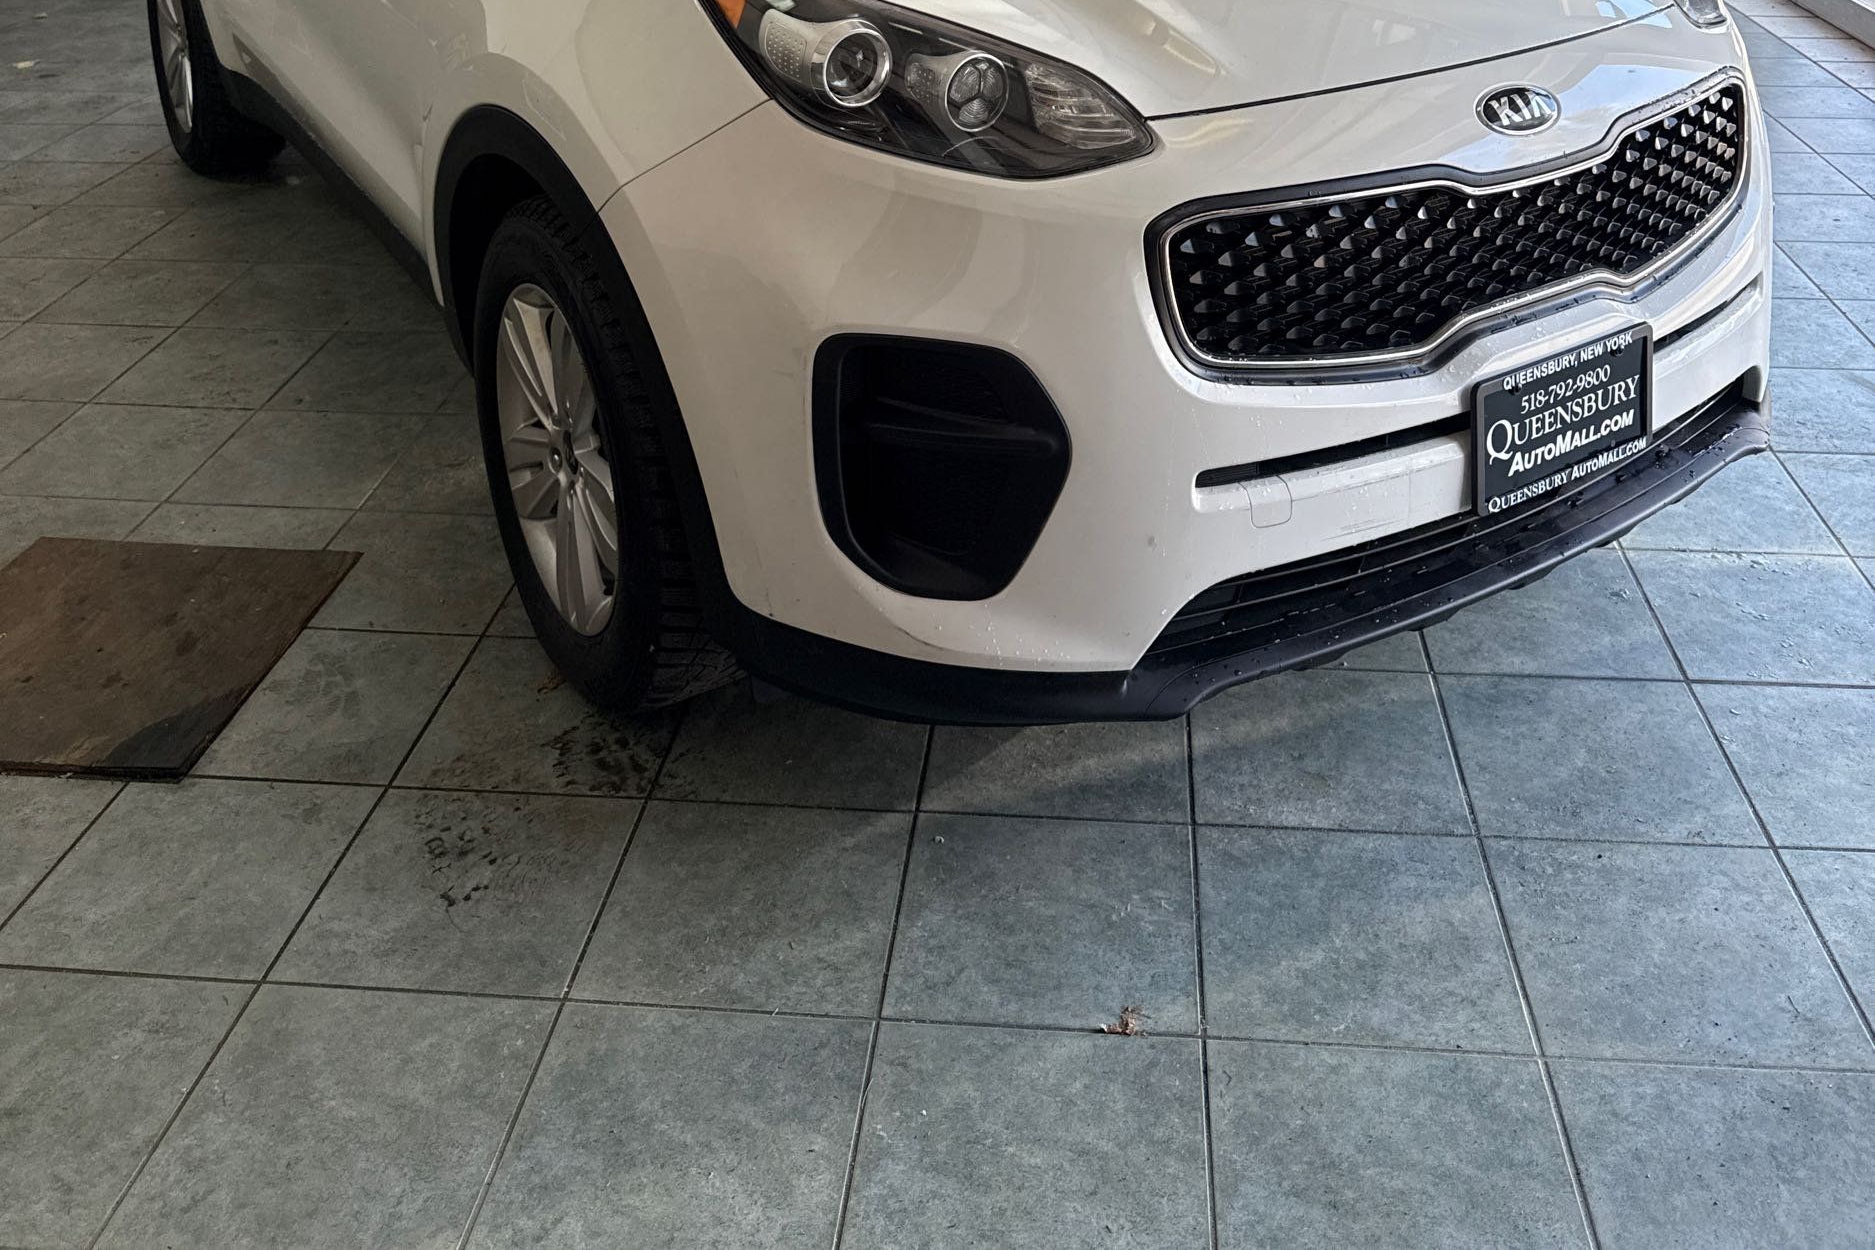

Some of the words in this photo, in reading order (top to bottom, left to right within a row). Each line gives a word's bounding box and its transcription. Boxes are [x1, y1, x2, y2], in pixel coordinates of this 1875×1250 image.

[1488, 91, 1552, 126] KIA
[1503, 352, 1578, 390] QUEENSBURY,
[1580, 343, 1604, 363] NEW
[1606, 331, 1633, 352] YORK
[1520, 364, 1611, 414] 518-792-9800
[1486, 374, 1640, 466] QUEENSBURY
[1488, 468, 1571, 514] QUEENSBURY
